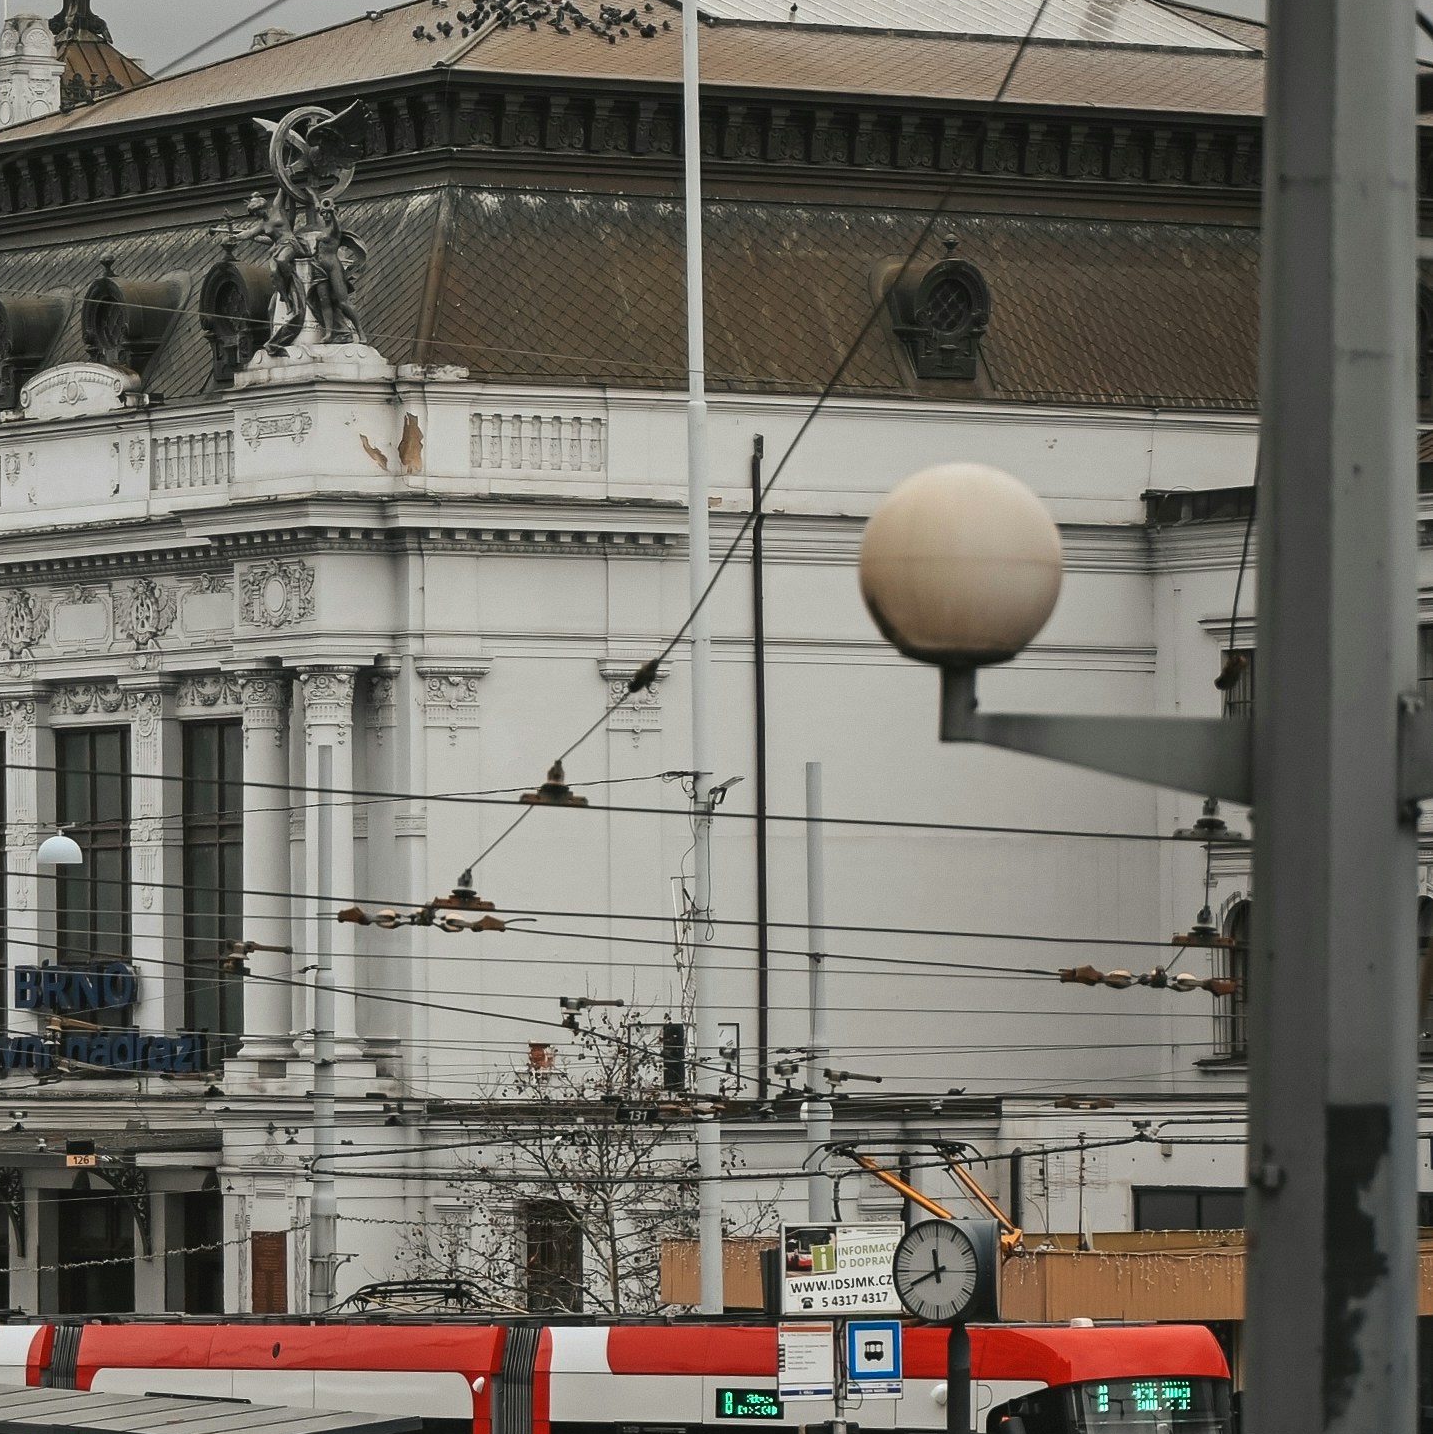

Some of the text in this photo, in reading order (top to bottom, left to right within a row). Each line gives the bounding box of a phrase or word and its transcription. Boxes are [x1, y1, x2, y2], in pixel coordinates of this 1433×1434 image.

[14, 961, 136, 1009] BRNO
[629, 1110, 647, 1121] 131
[73, 1156, 90, 1165] 126
[790, 1275, 893, 1294] WWW.IDSJMK.CZ
[822, 1291, 888, 1308] 5 4317 4317
